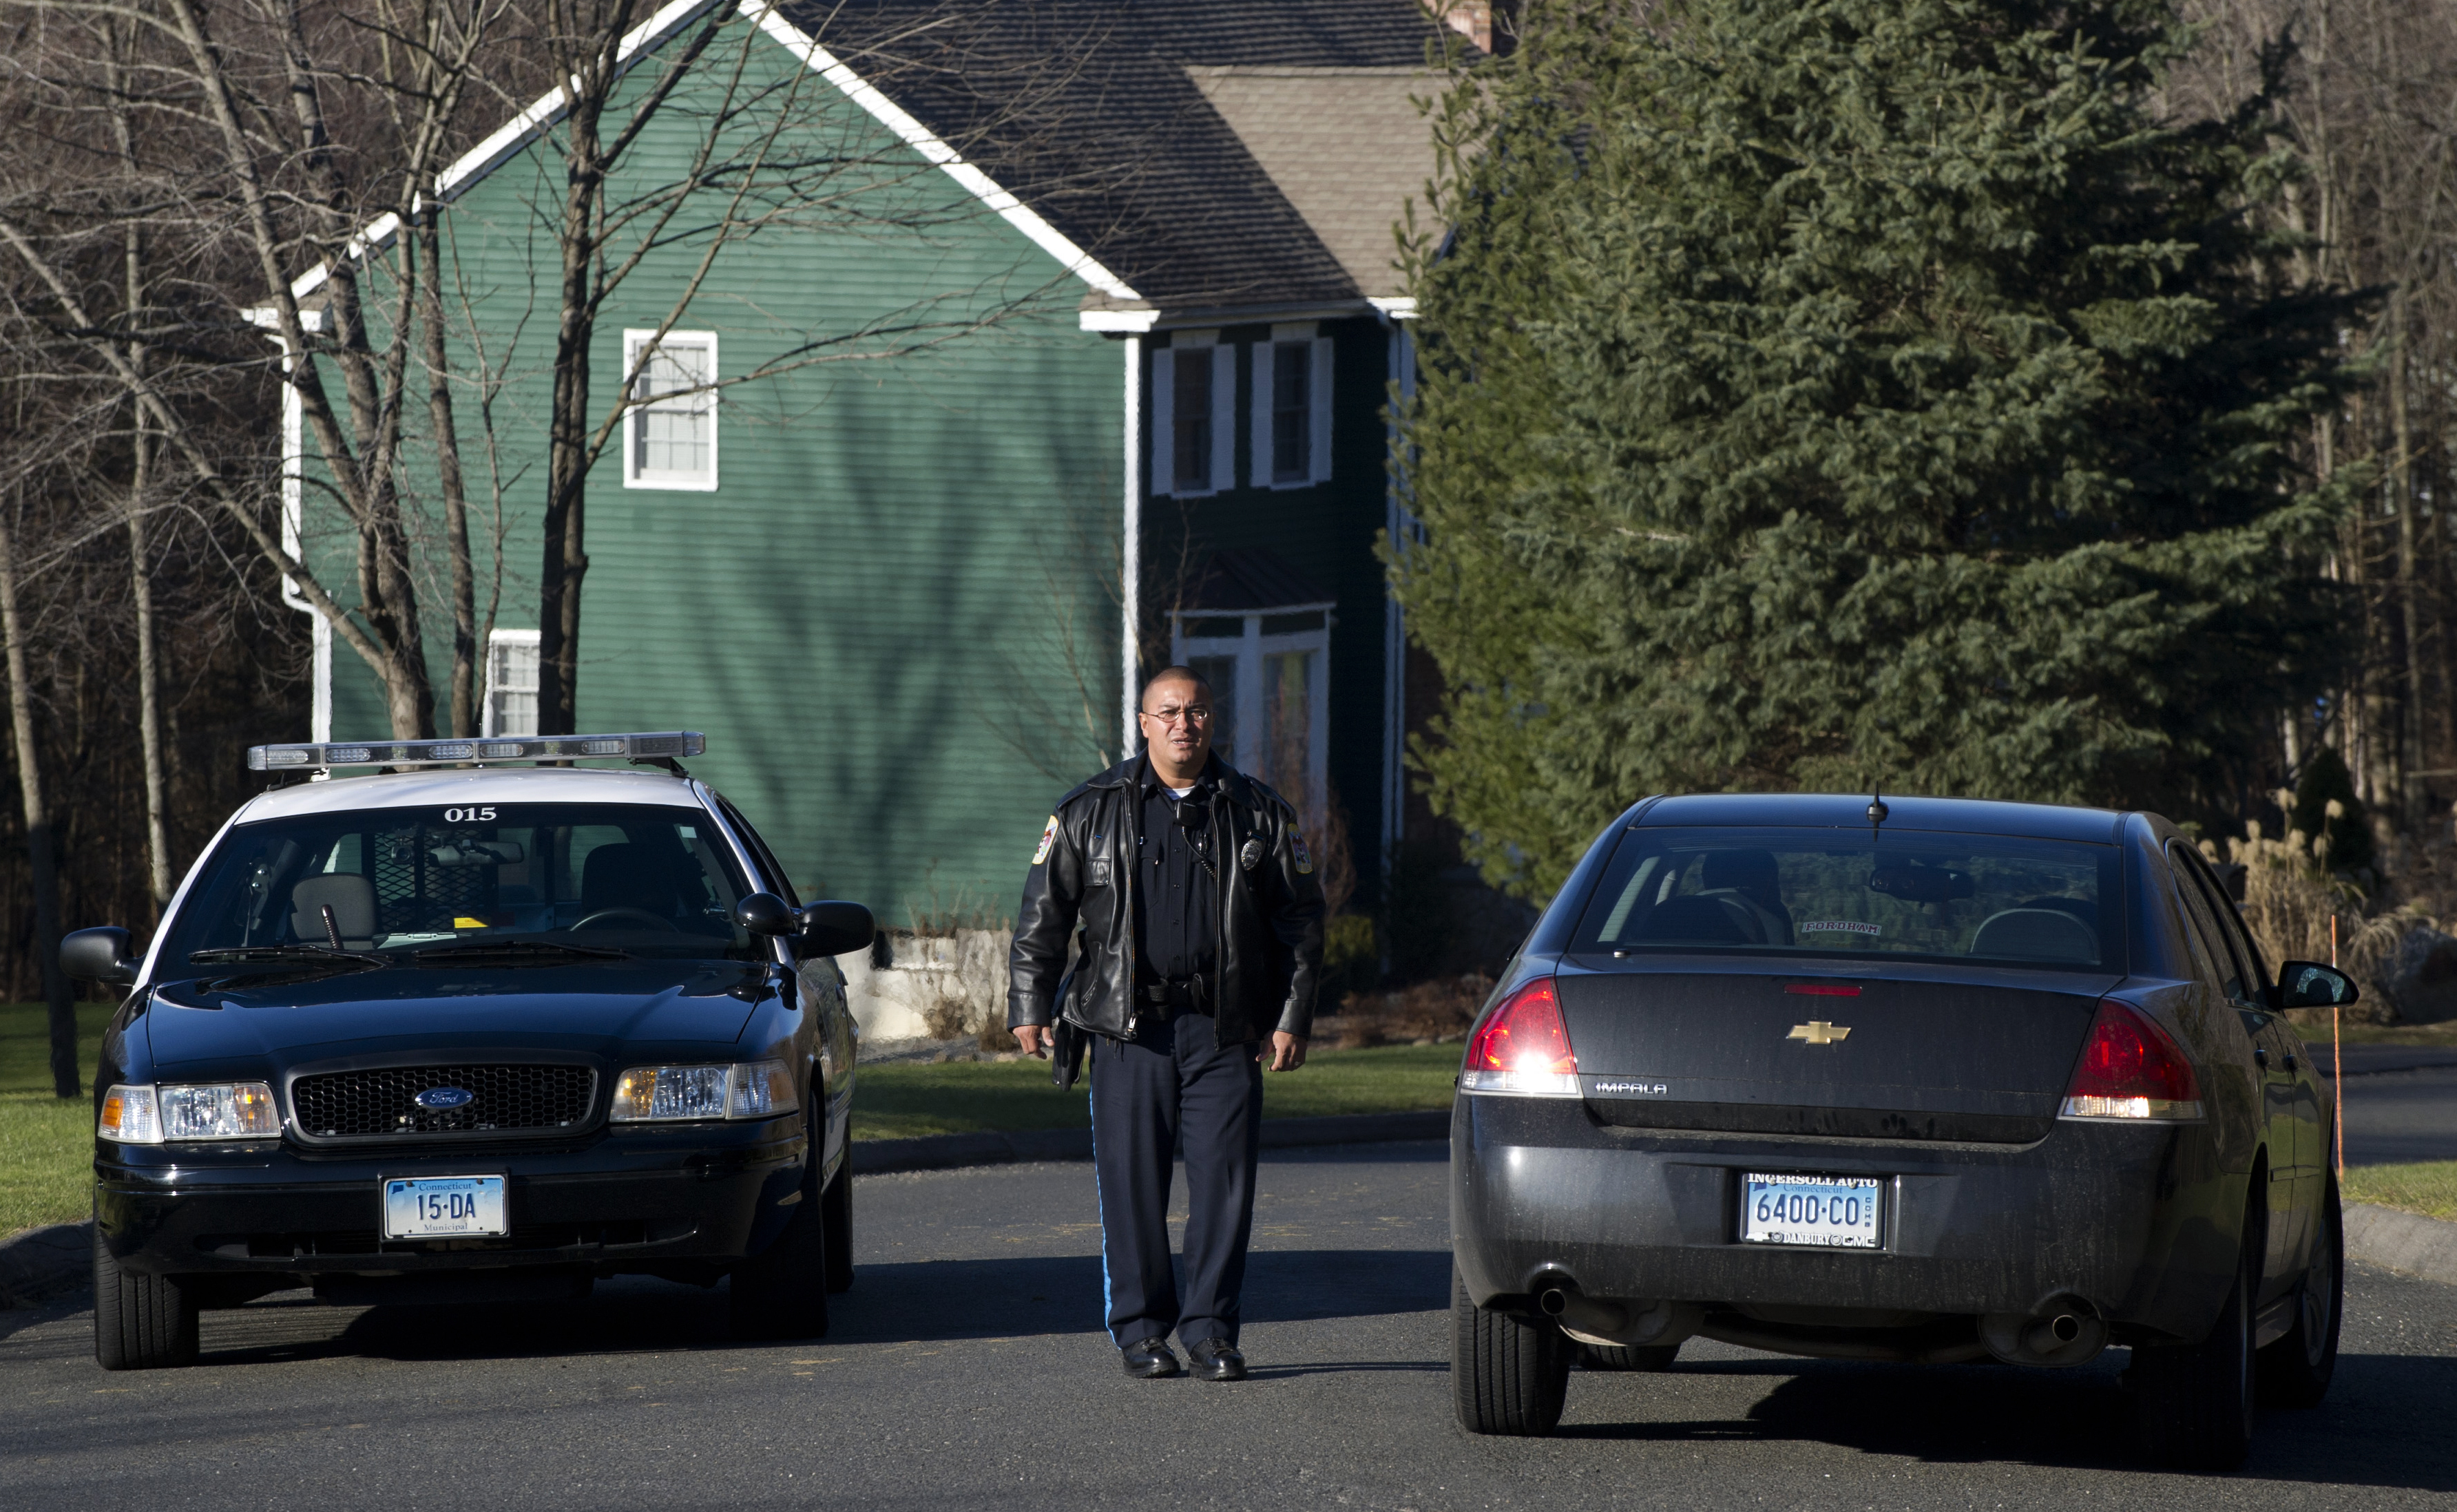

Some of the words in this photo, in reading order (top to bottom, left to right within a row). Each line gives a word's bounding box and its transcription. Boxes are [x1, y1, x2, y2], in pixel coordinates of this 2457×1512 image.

[444, 807, 496, 822] 015
[1806, 922, 1879, 934] FORDHAM
[1596, 1082, 1668, 1095] IMPALA
[429, 1091, 459, 1104] Ford
[1748, 1173, 1834, 1186] INGERSOLL
[1836, 1177, 1878, 1188] AUTO
[419, 1183, 472, 1191] Connecticut
[1784, 1184, 1843, 1194] Connecticut
[424, 1223, 468, 1232] Municipal
[1783, 1232, 1831, 1246] DANBURY
[1842, 1235, 1876, 1247] GMC
